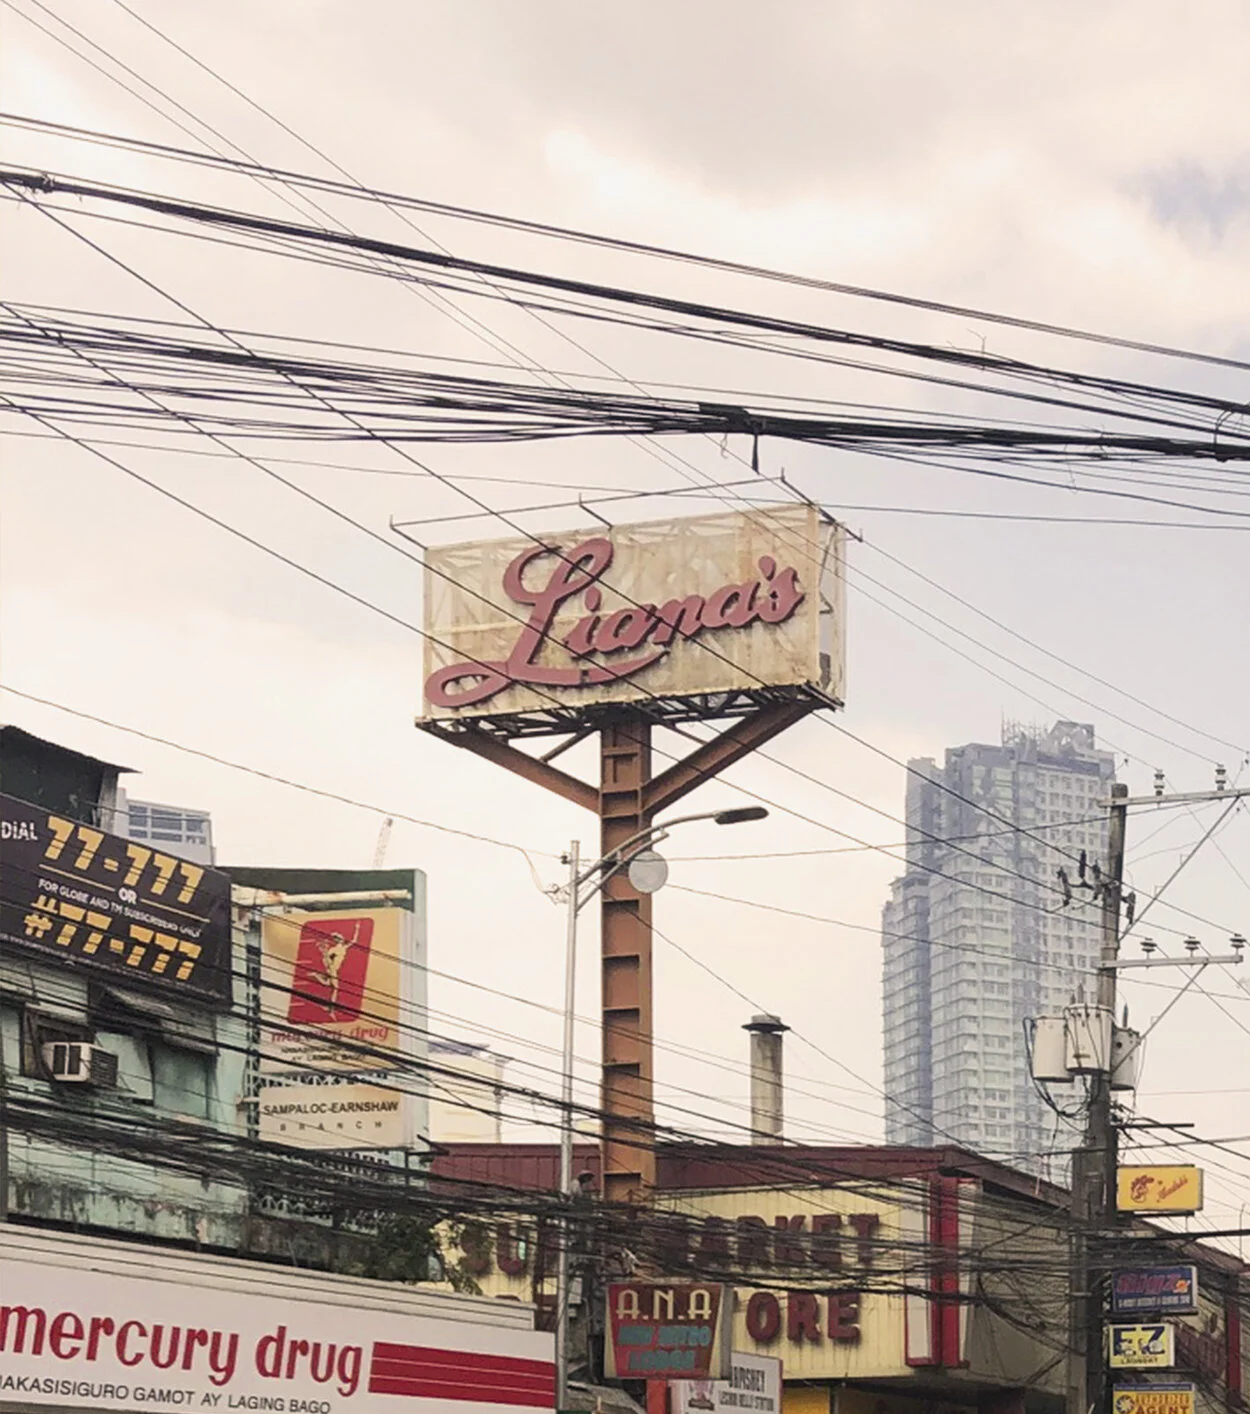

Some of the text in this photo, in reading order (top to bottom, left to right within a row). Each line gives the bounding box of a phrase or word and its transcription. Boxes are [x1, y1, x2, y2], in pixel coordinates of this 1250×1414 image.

[38, 878, 58, 894] FOR
[59, 885, 89, 904] GLOBE
[90, 895, 110, 910] AND
[118, 887, 138, 905] OR
[263, 1100, 400, 1115] SAMPALOC-EARNSHAW
[0, 1304, 363, 1398] mercury drug
[0, 1375, 332, 1414] AKASISIGURO GAMOT AY LAGING BAGO
